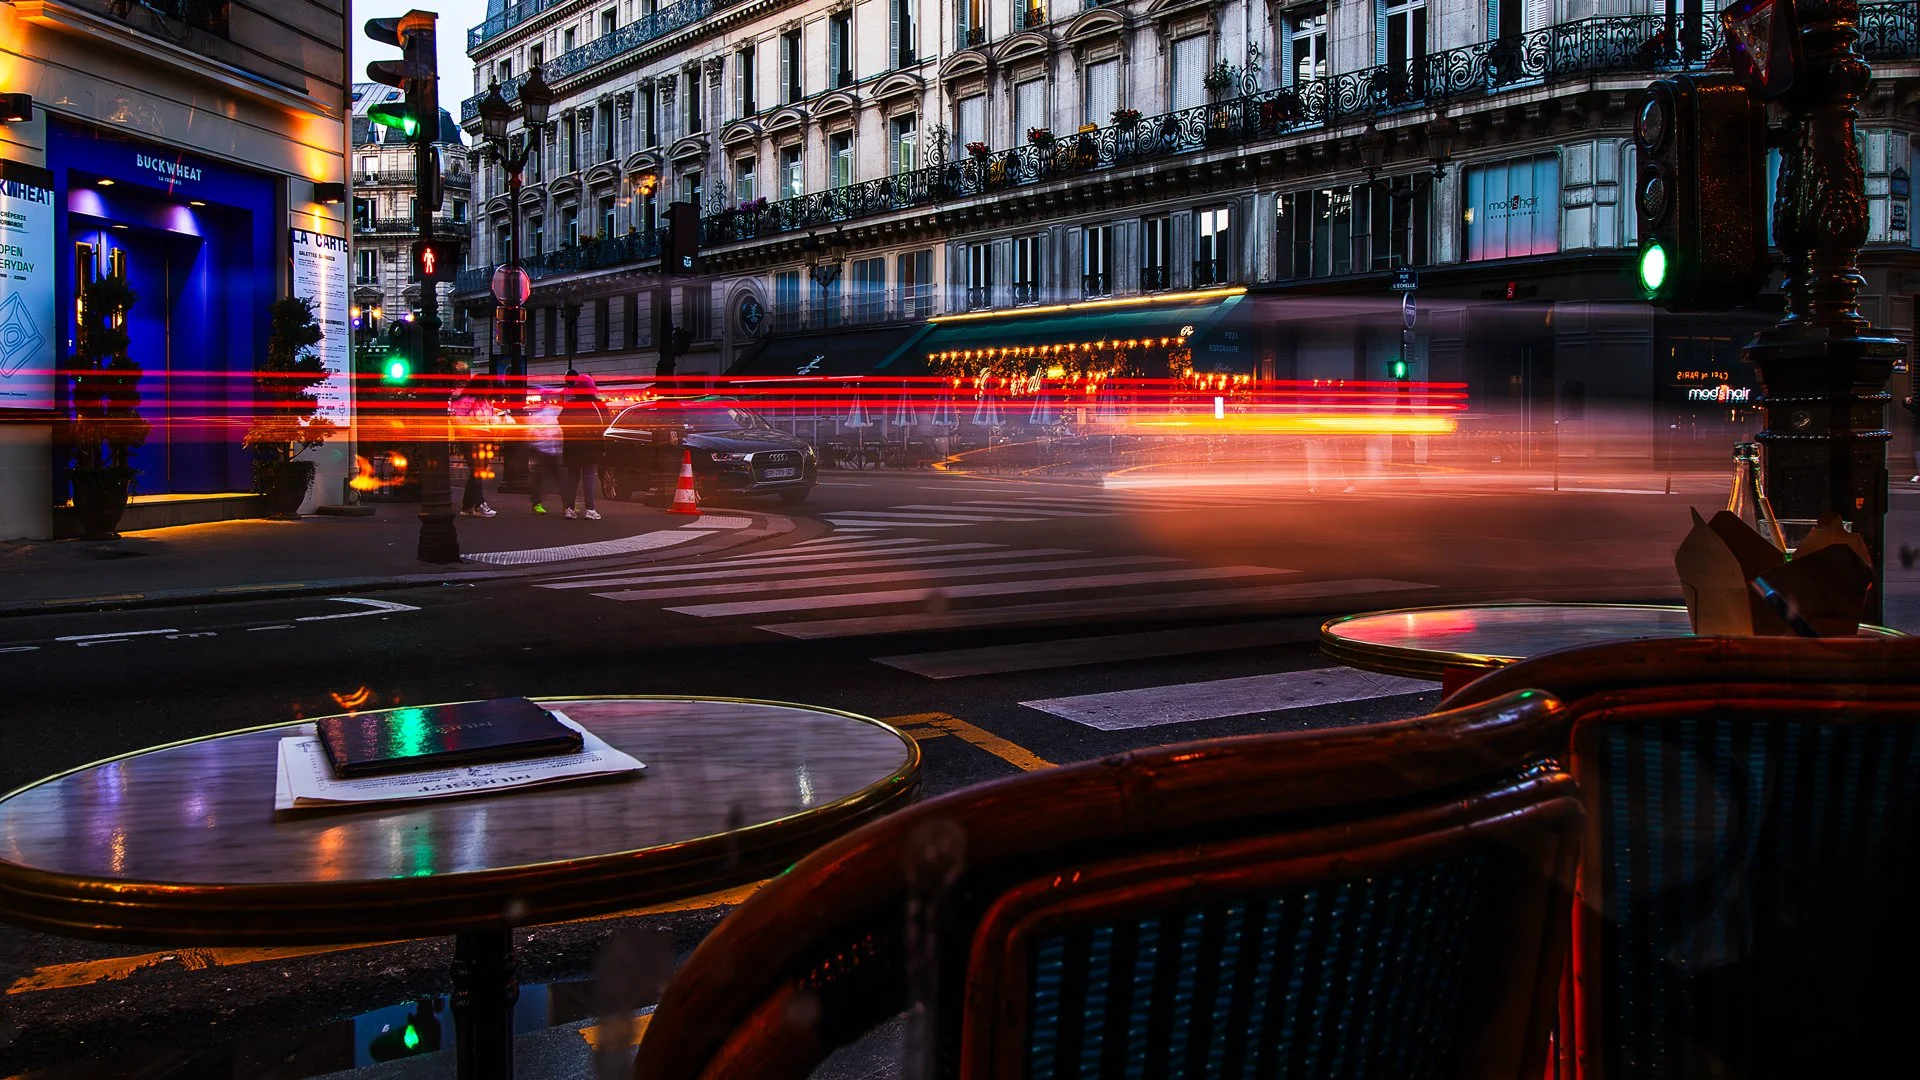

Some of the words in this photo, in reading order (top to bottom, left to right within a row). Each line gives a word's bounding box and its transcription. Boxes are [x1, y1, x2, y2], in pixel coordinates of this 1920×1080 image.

[136, 153, 202, 181] BUCKWHEAT
[1487, 210, 1541, 220] INTERNATIONAL
[292, 230, 309, 246] LA
[315, 234, 348, 253] CARTE
[1224, 331, 1239, 340] PIZZA
[1208, 344, 1239, 353] RISTORANTE
